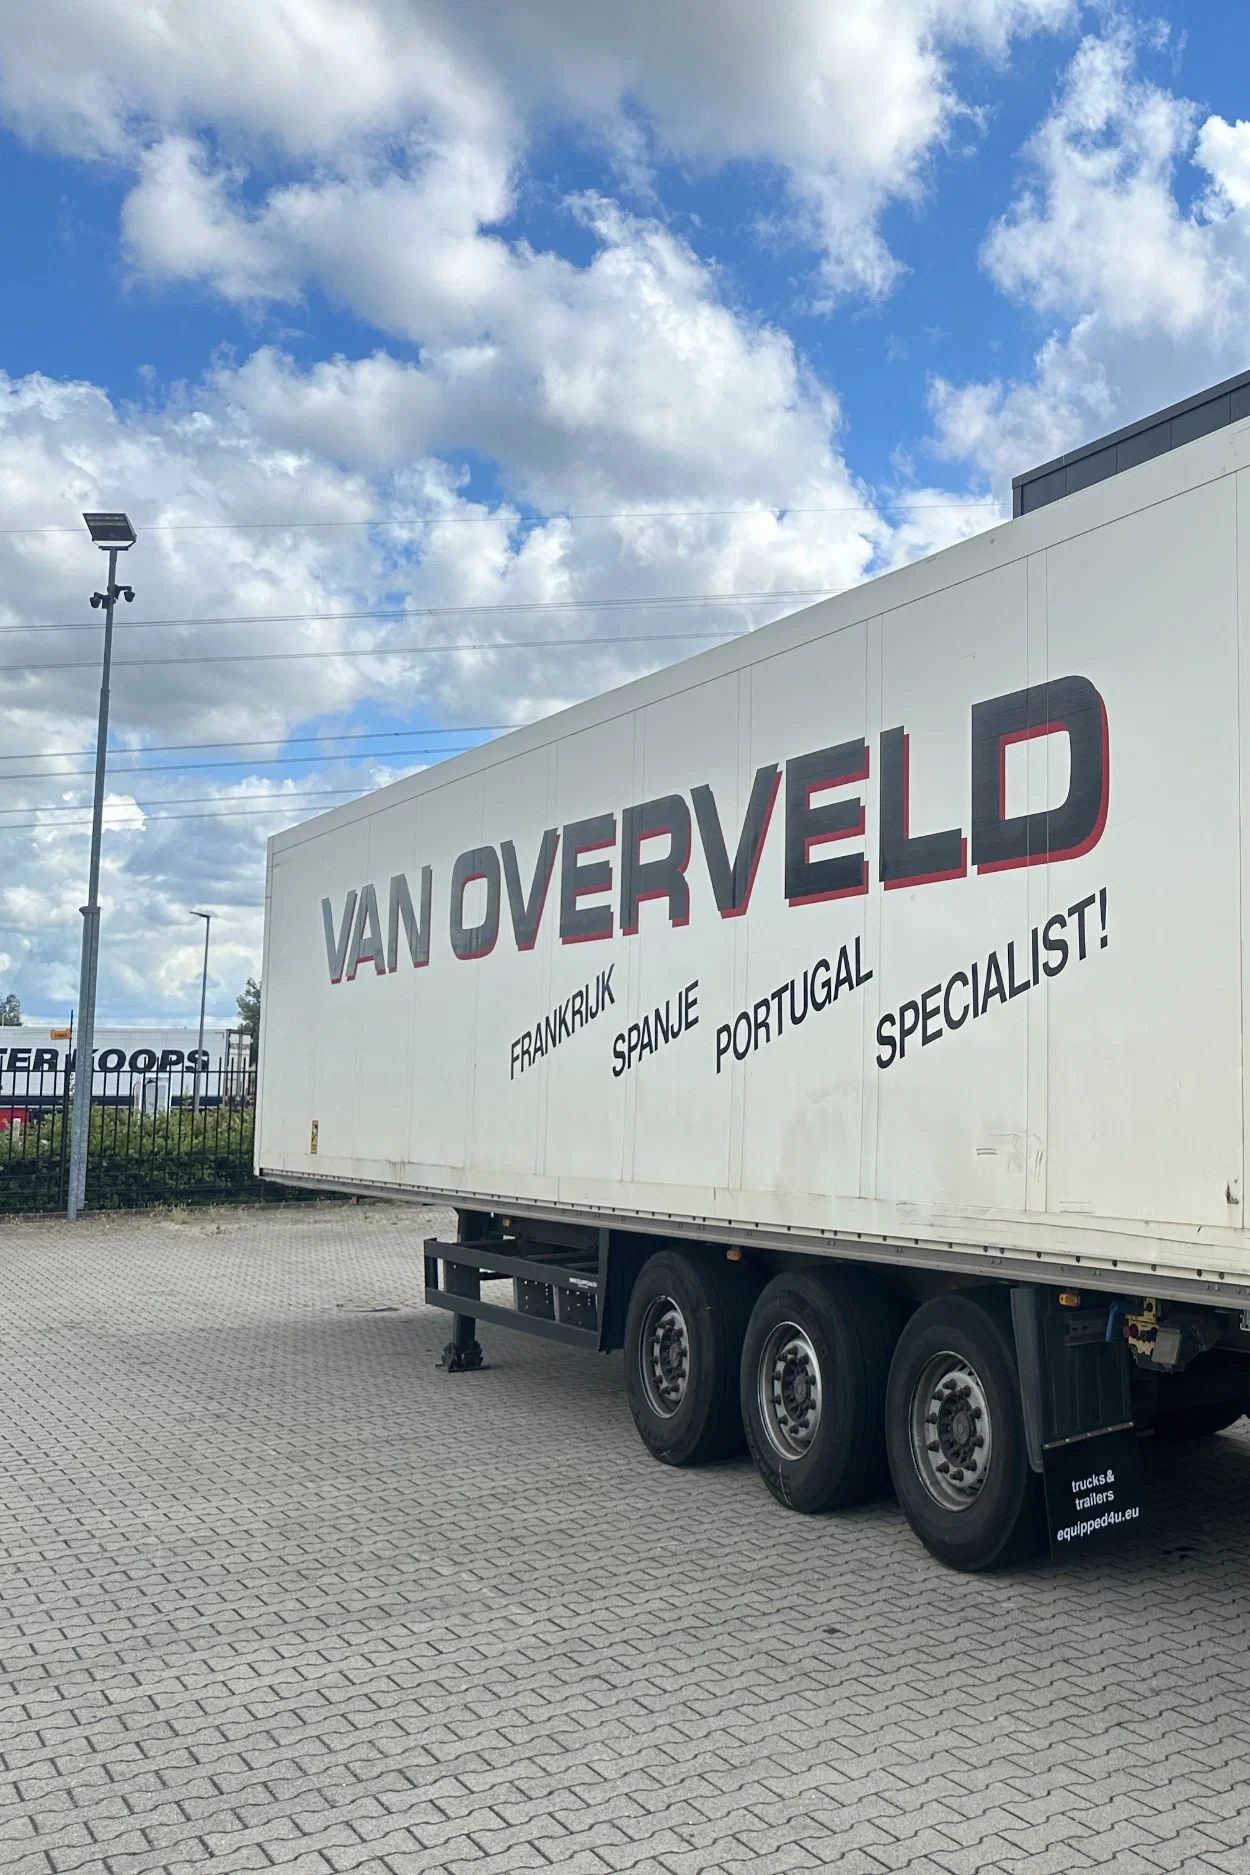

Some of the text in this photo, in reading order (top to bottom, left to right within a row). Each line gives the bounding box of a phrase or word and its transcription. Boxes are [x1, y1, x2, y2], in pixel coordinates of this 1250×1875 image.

[321, 674, 1111, 986] VAN OVERVELD
[509, 962, 617, 1082] FRANKRIJK
[611, 978, 701, 1079] SPANJE
[715, 934, 875, 1075] PORTUGAL
[875, 886, 1110, 1070] SPECIALIST!
[1056, 1506, 1140, 1542] equipped4u.eu
[1075, 1490, 1115, 1511] trailers
